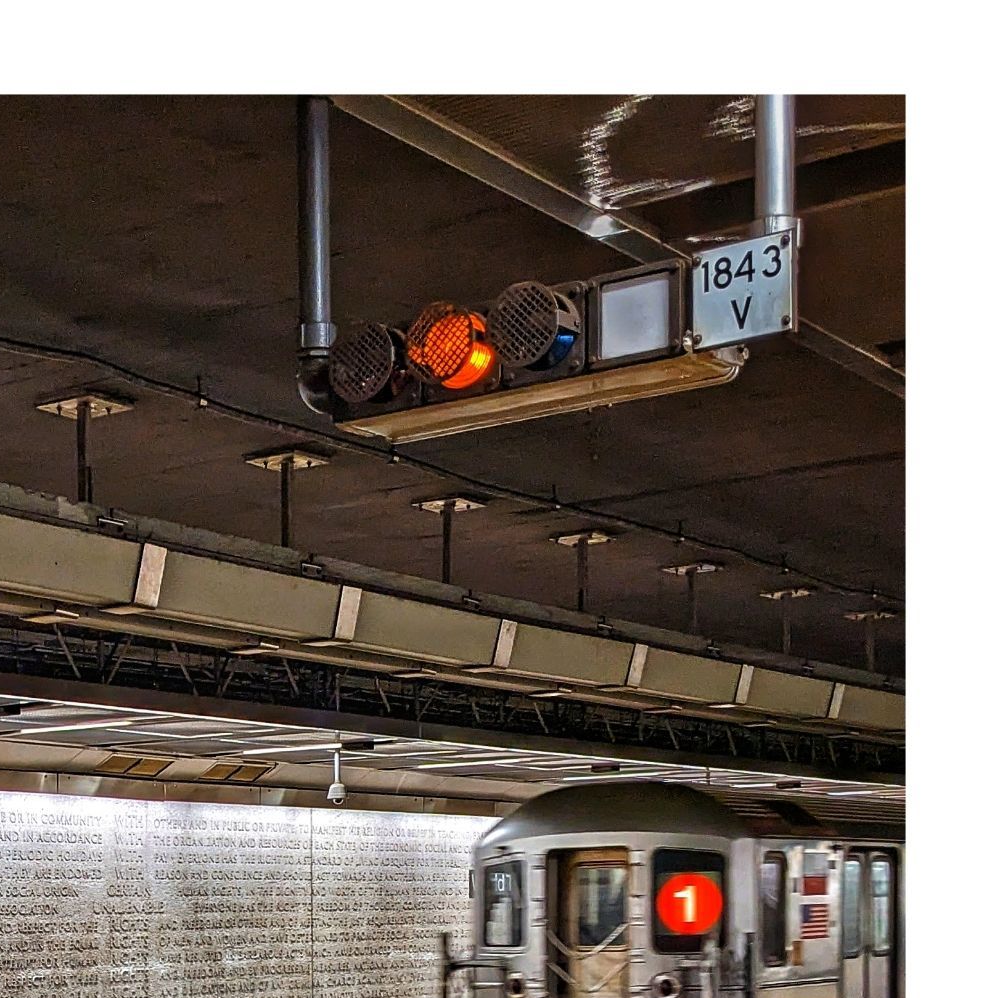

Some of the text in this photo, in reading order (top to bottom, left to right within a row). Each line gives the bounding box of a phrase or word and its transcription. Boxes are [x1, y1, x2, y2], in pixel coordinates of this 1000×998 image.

[701, 245, 783, 293] 1843
[731, 296, 752, 330] V
[9, 812, 24, 823] OR
[27, 813, 36, 824] IN
[41, 813, 101, 826] COMMUNITY
[114, 816, 143, 828] WITH
[223, 821, 249, 832] PUBLIC
[23, 831, 33, 842] IN
[36, 831, 102, 844] ACCORDANCE
[115, 833, 143, 845] WITH
[673, 885, 698, 924] 1
